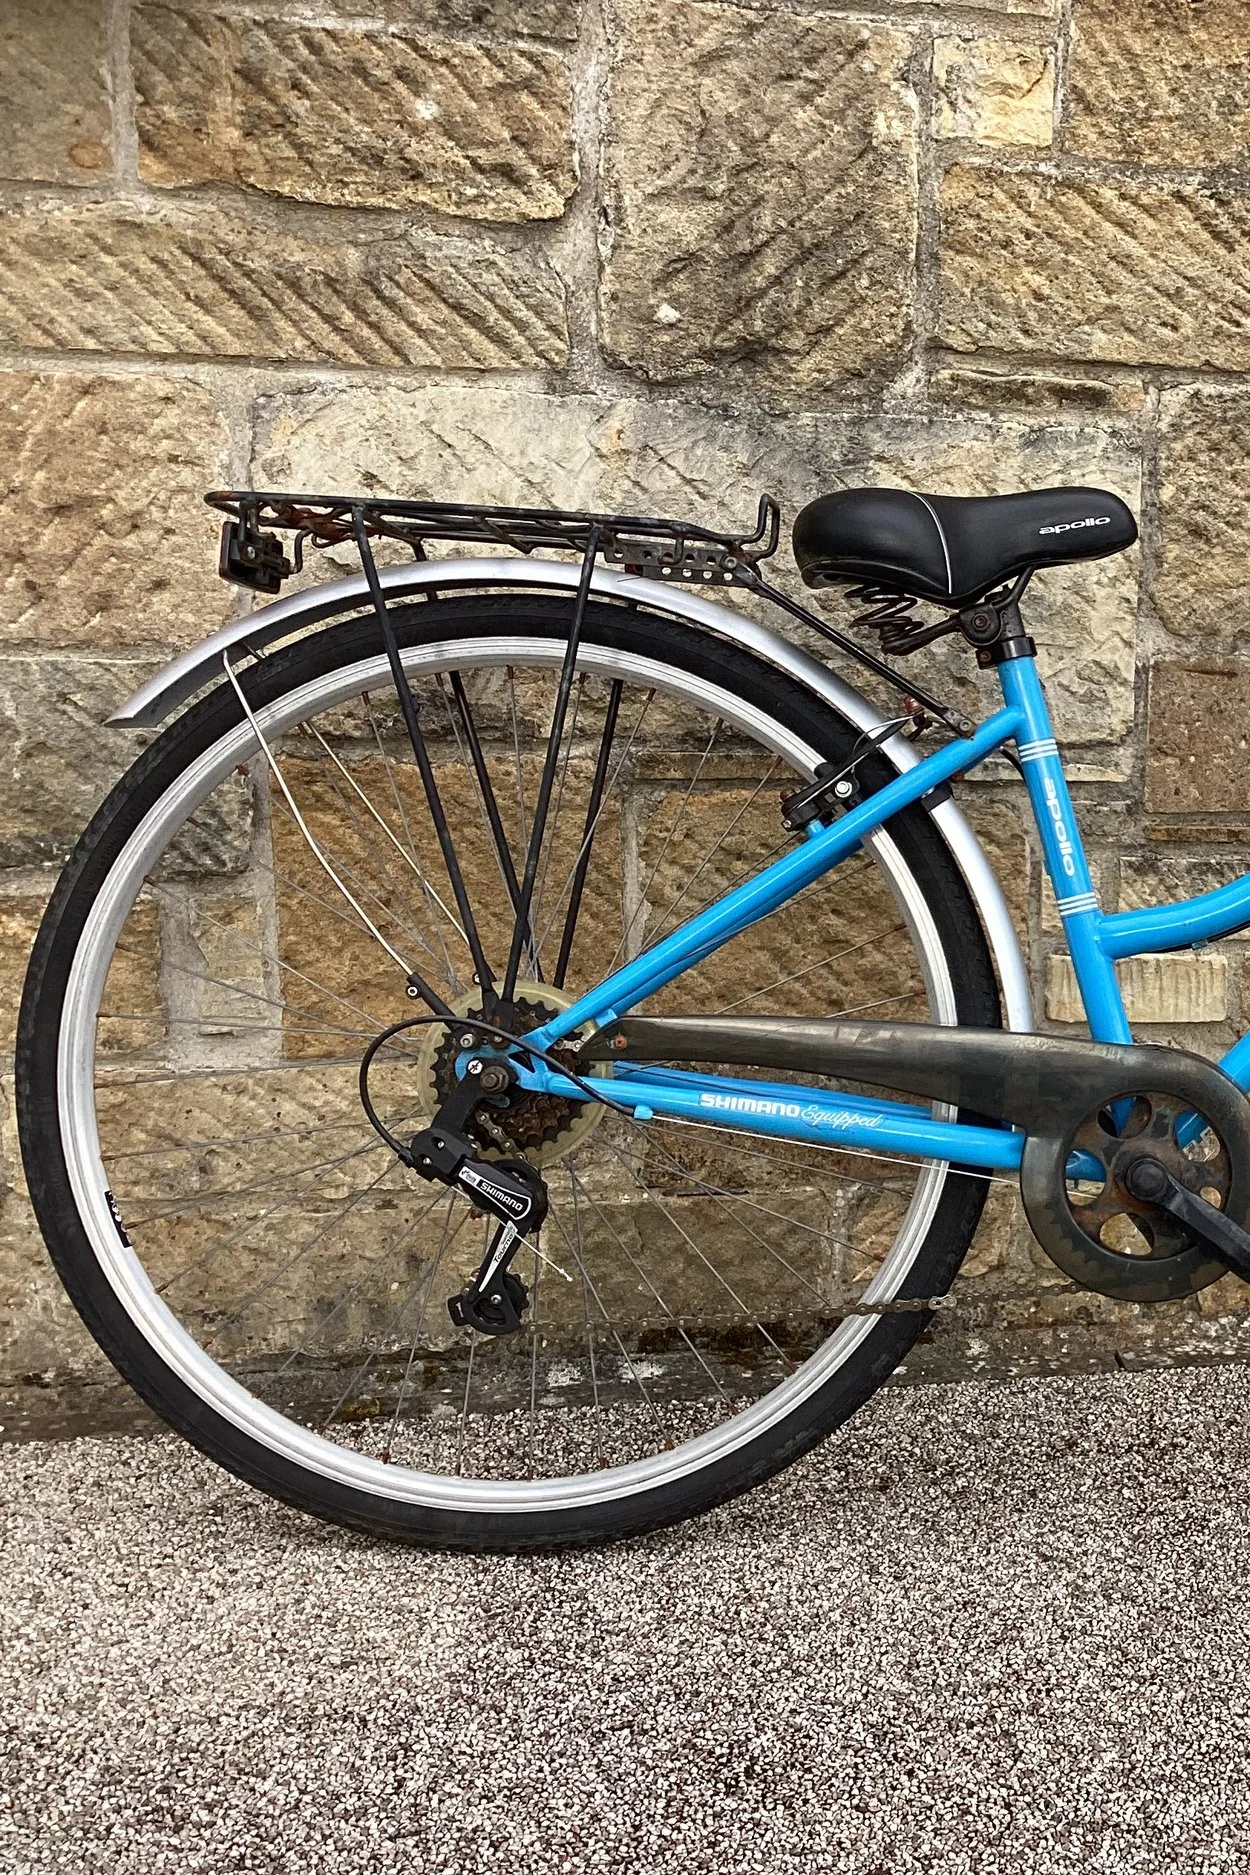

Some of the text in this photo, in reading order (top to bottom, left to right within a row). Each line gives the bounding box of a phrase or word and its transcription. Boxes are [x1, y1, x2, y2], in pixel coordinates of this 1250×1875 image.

[1039, 516, 1111, 535] apollo
[1044, 777, 1076, 877] apollo
[701, 1093, 884, 1130] SHIMANO Equipped
[480, 1182, 524, 1211] SHIMANO
